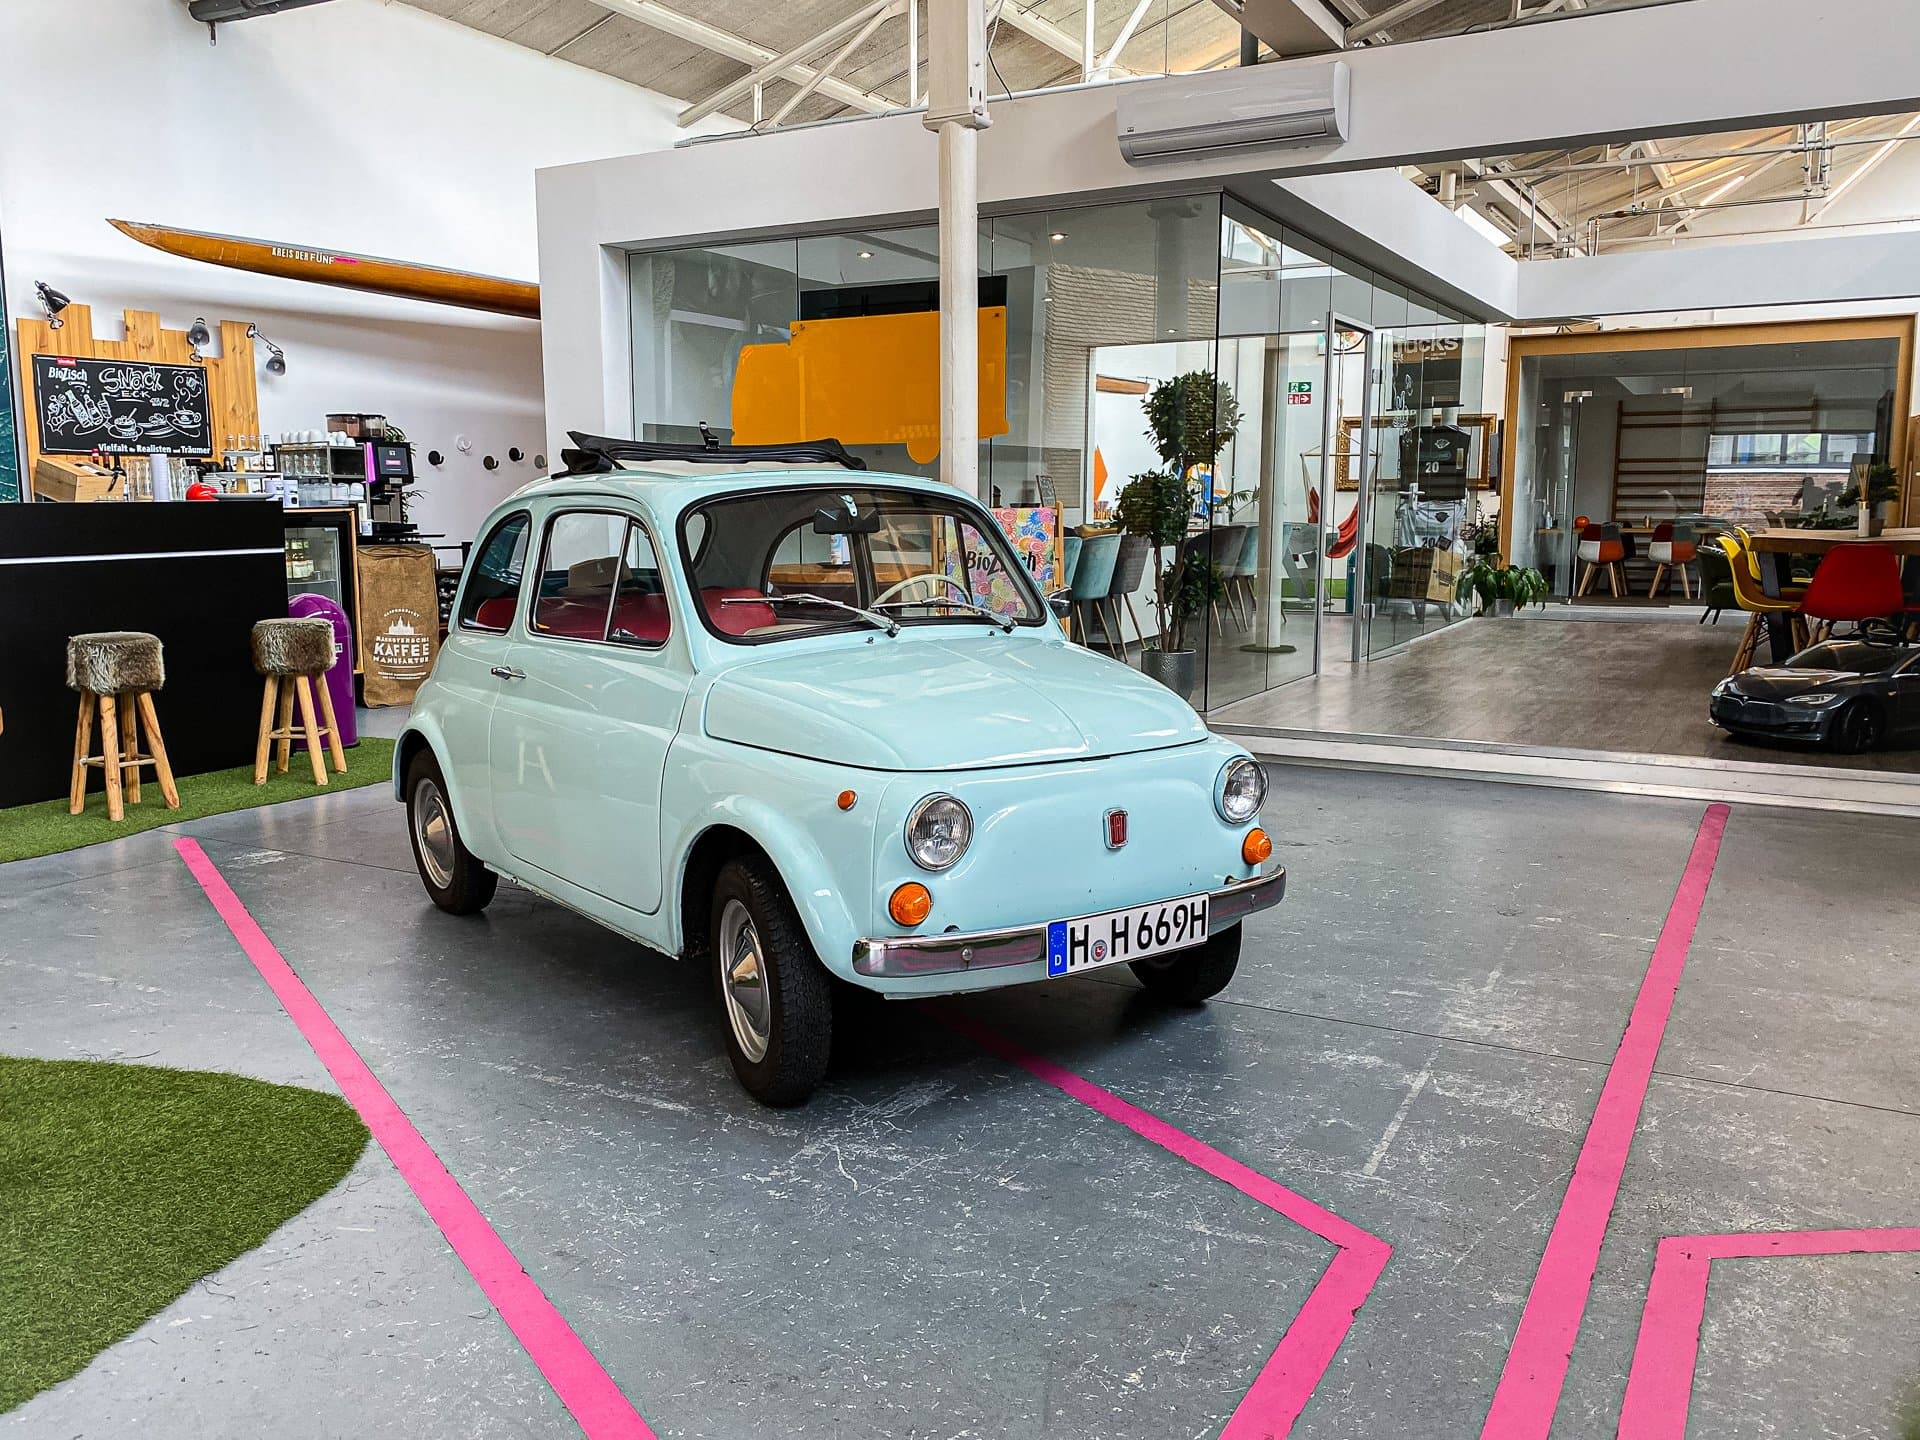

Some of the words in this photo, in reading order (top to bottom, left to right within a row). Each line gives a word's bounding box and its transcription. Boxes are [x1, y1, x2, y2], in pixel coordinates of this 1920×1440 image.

[98, 443, 128, 453] Vielfalt
[136, 444, 172, 453] Realisten
[180, 446, 211, 454] Träumer
[1425, 461, 1440, 473] 20
[966, 551, 1036, 576] BioZh
[374, 642, 430, 657] KAFFEE
[1069, 924, 1090, 966] H
[1111, 915, 1130, 957] H
[1137, 899, 1207, 951] 669H
[1054, 954, 1062, 967] D
